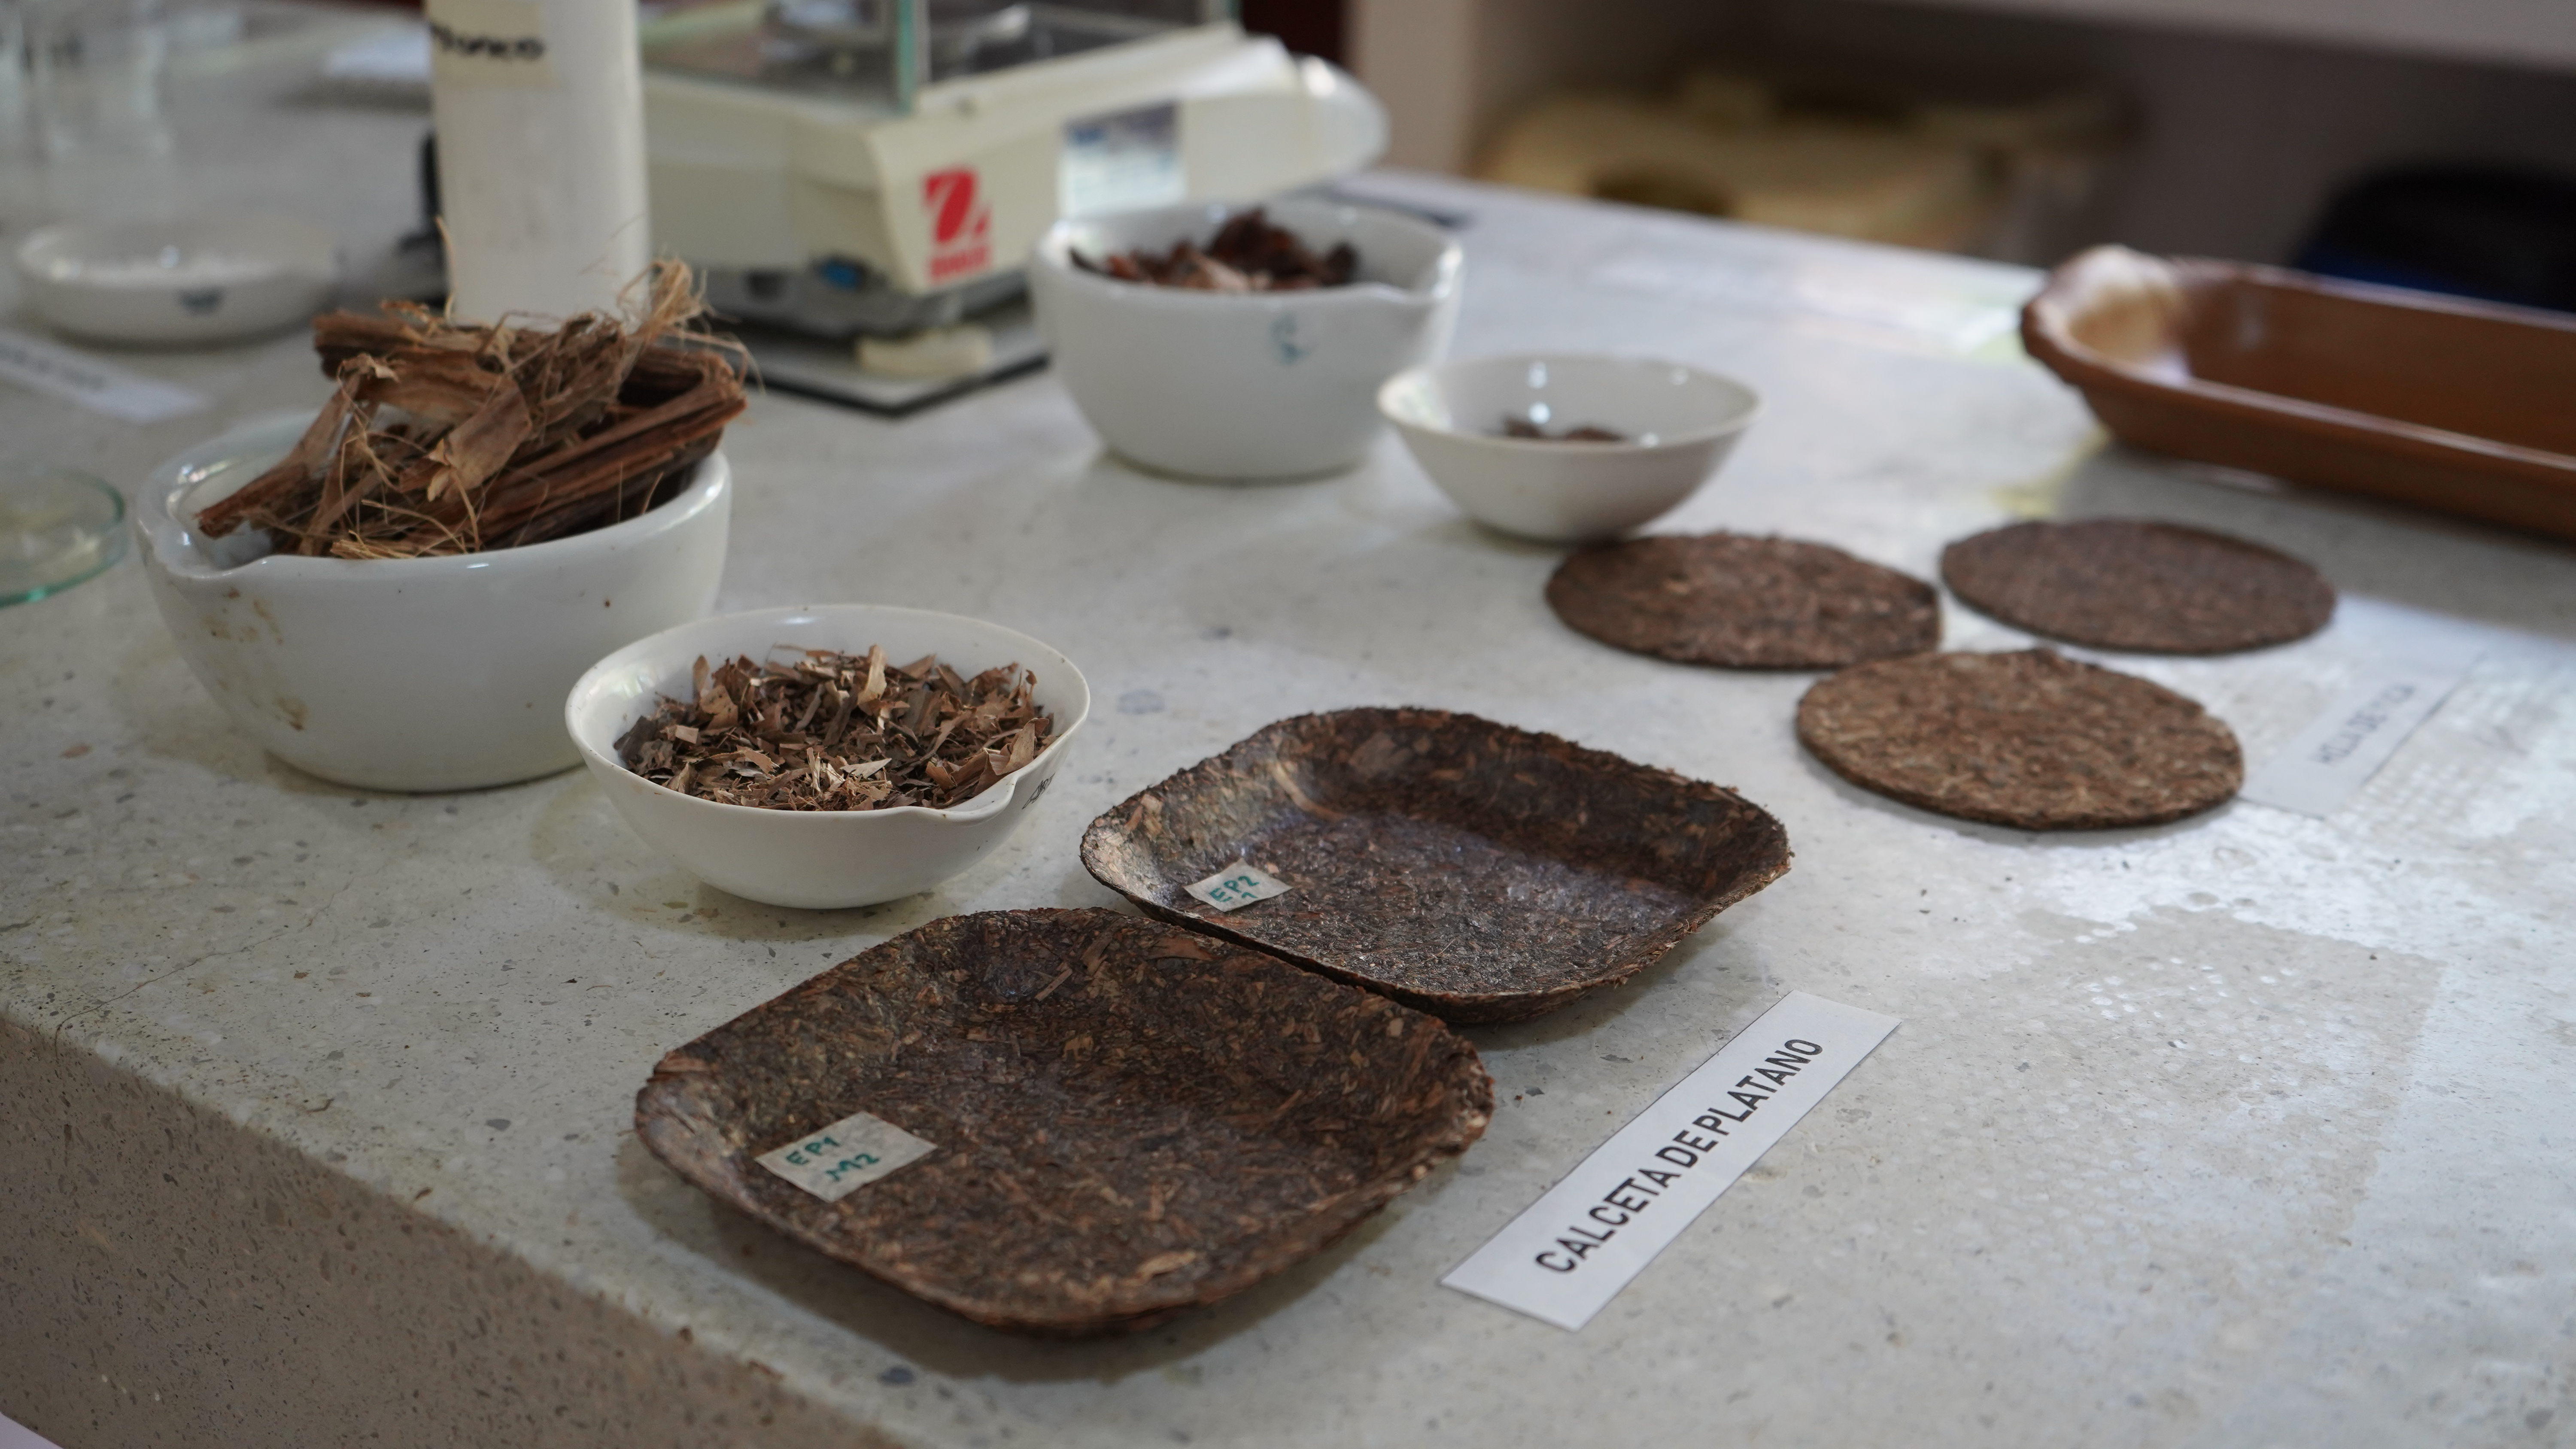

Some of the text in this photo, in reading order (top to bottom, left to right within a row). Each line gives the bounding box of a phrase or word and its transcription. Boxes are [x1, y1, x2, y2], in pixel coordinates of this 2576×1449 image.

[1209, 876, 1259, 902] EP2
[785, 1136, 840, 1166] EP1
[1534, 1038, 1823, 1273] CALCETA DE PLATANO
